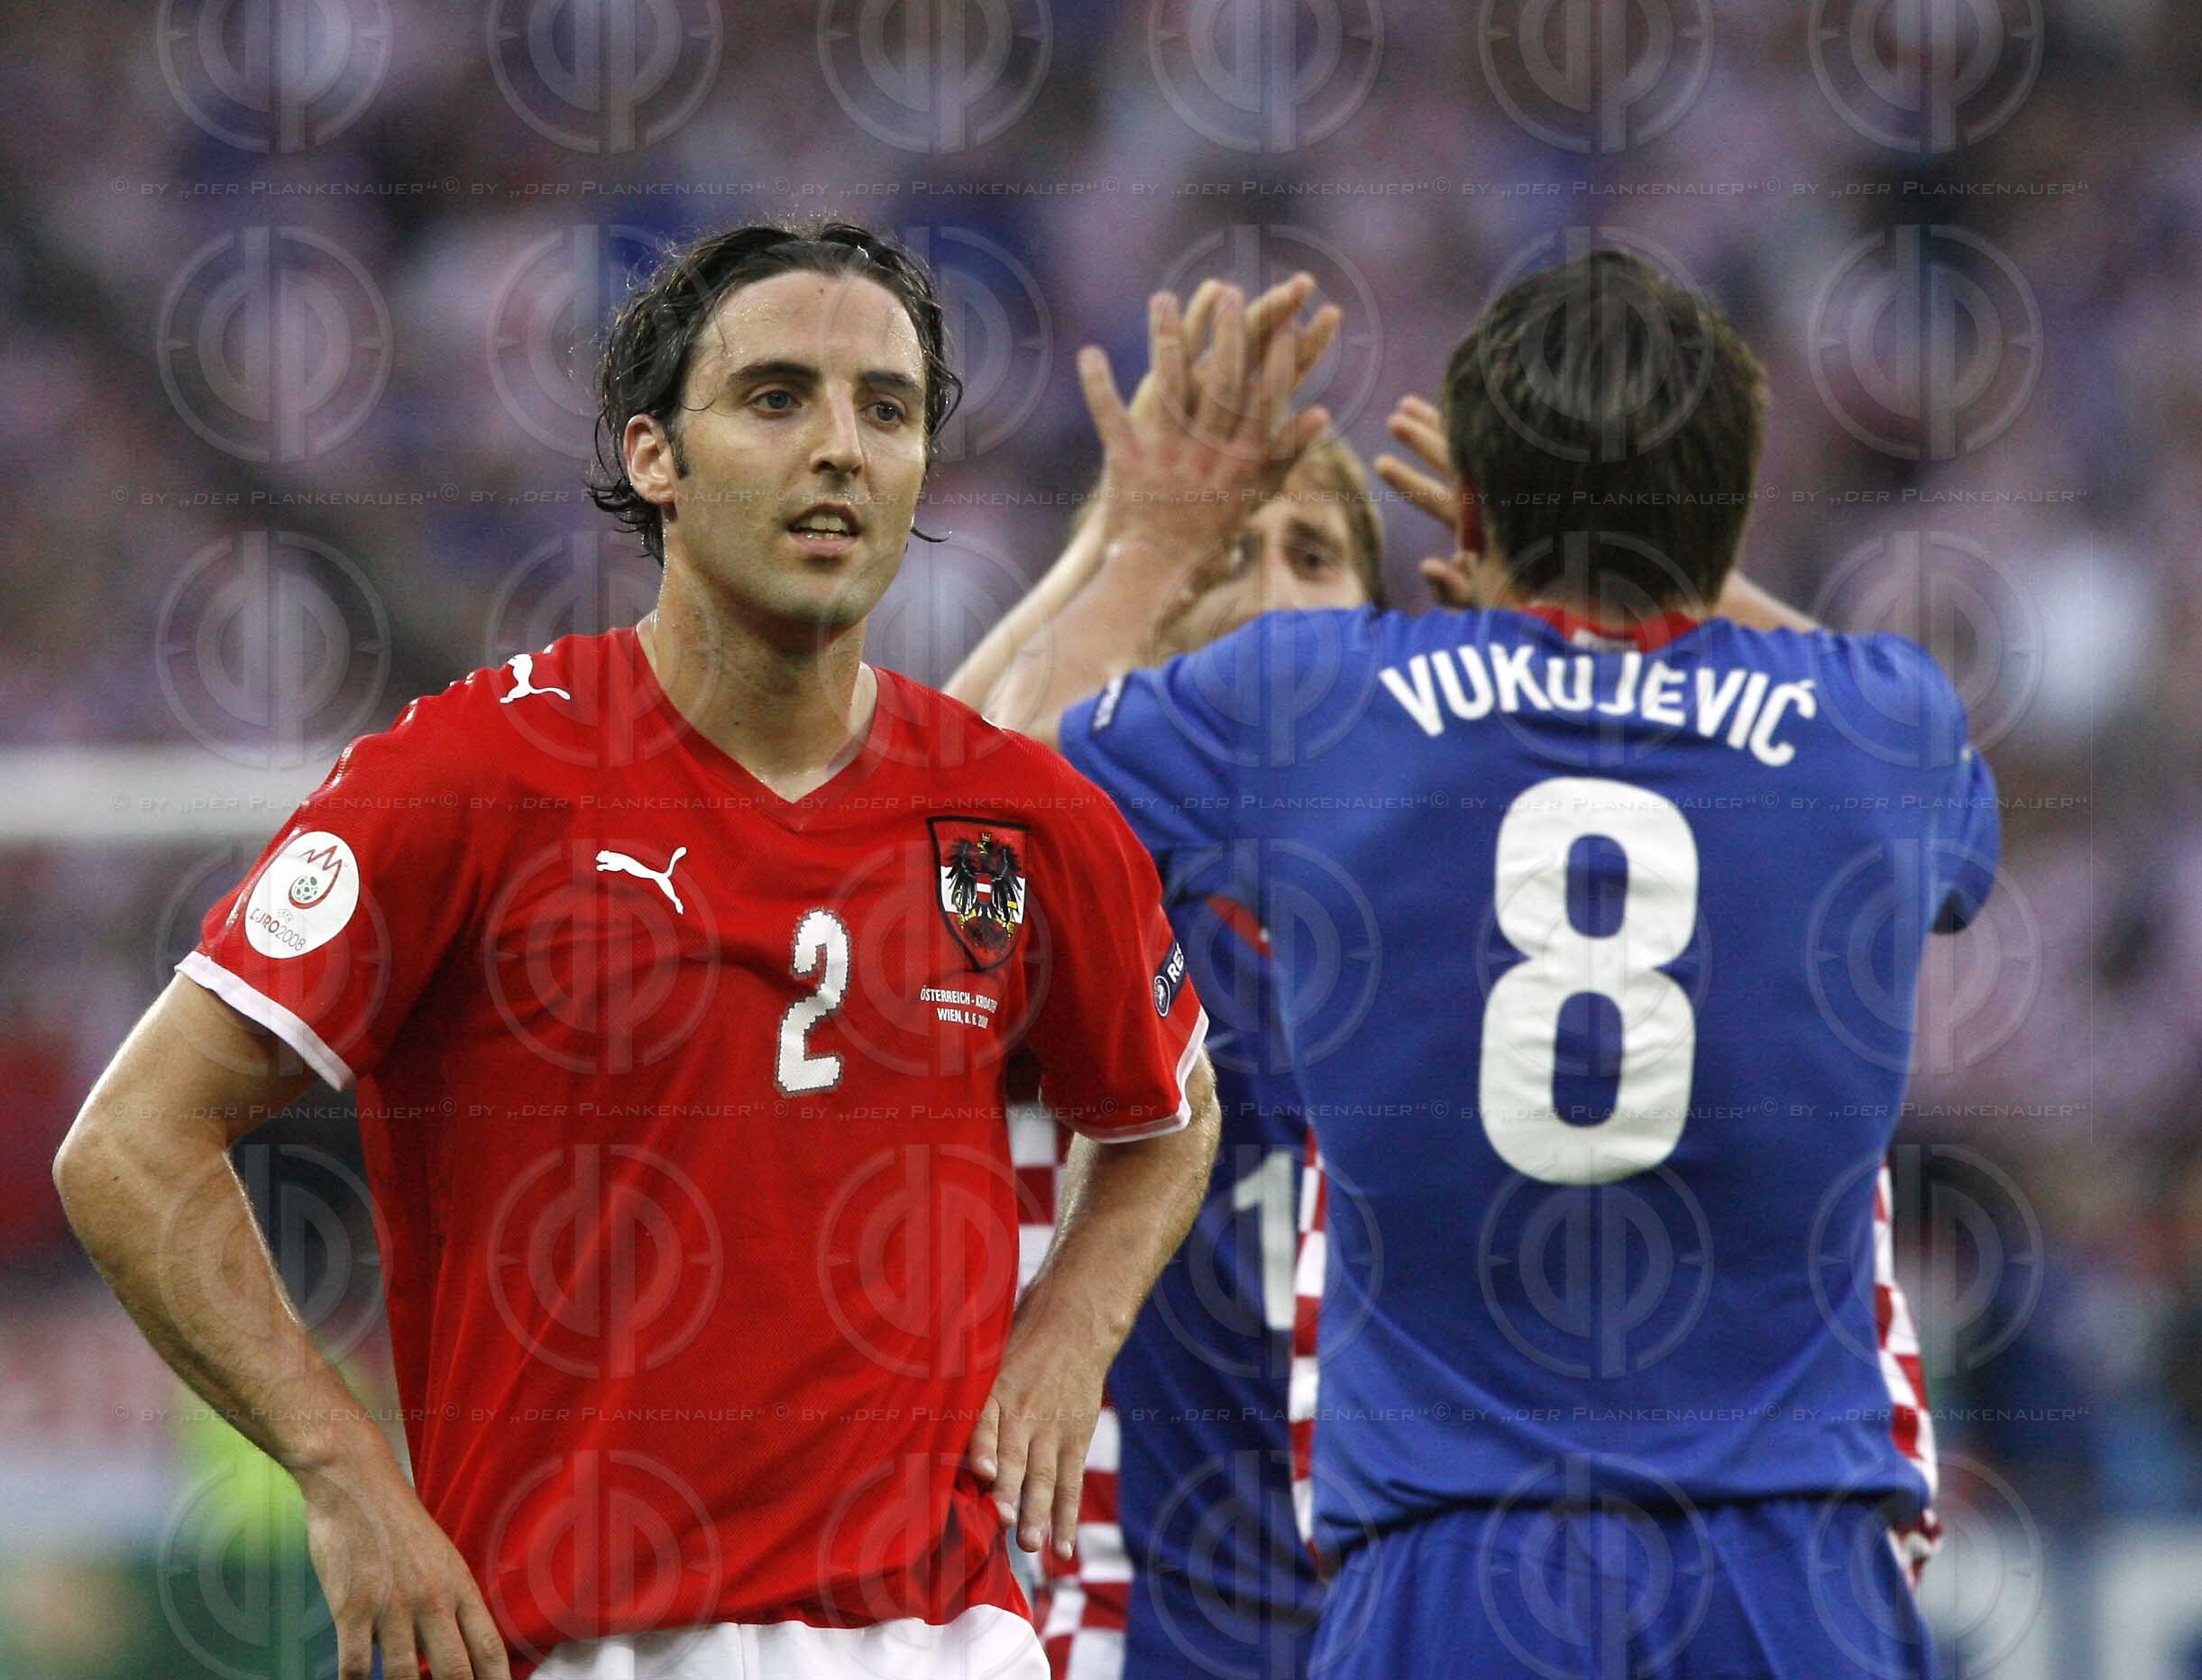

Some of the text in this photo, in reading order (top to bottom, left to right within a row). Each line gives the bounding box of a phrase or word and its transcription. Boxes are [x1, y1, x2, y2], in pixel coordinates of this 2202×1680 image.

[777, 909, 849, 1094] 2
[920, 984, 970, 1005] ÖSTERREICH
[1479, 776, 1699, 1186] 8
[1234, 1152, 1296, 1329] 1
